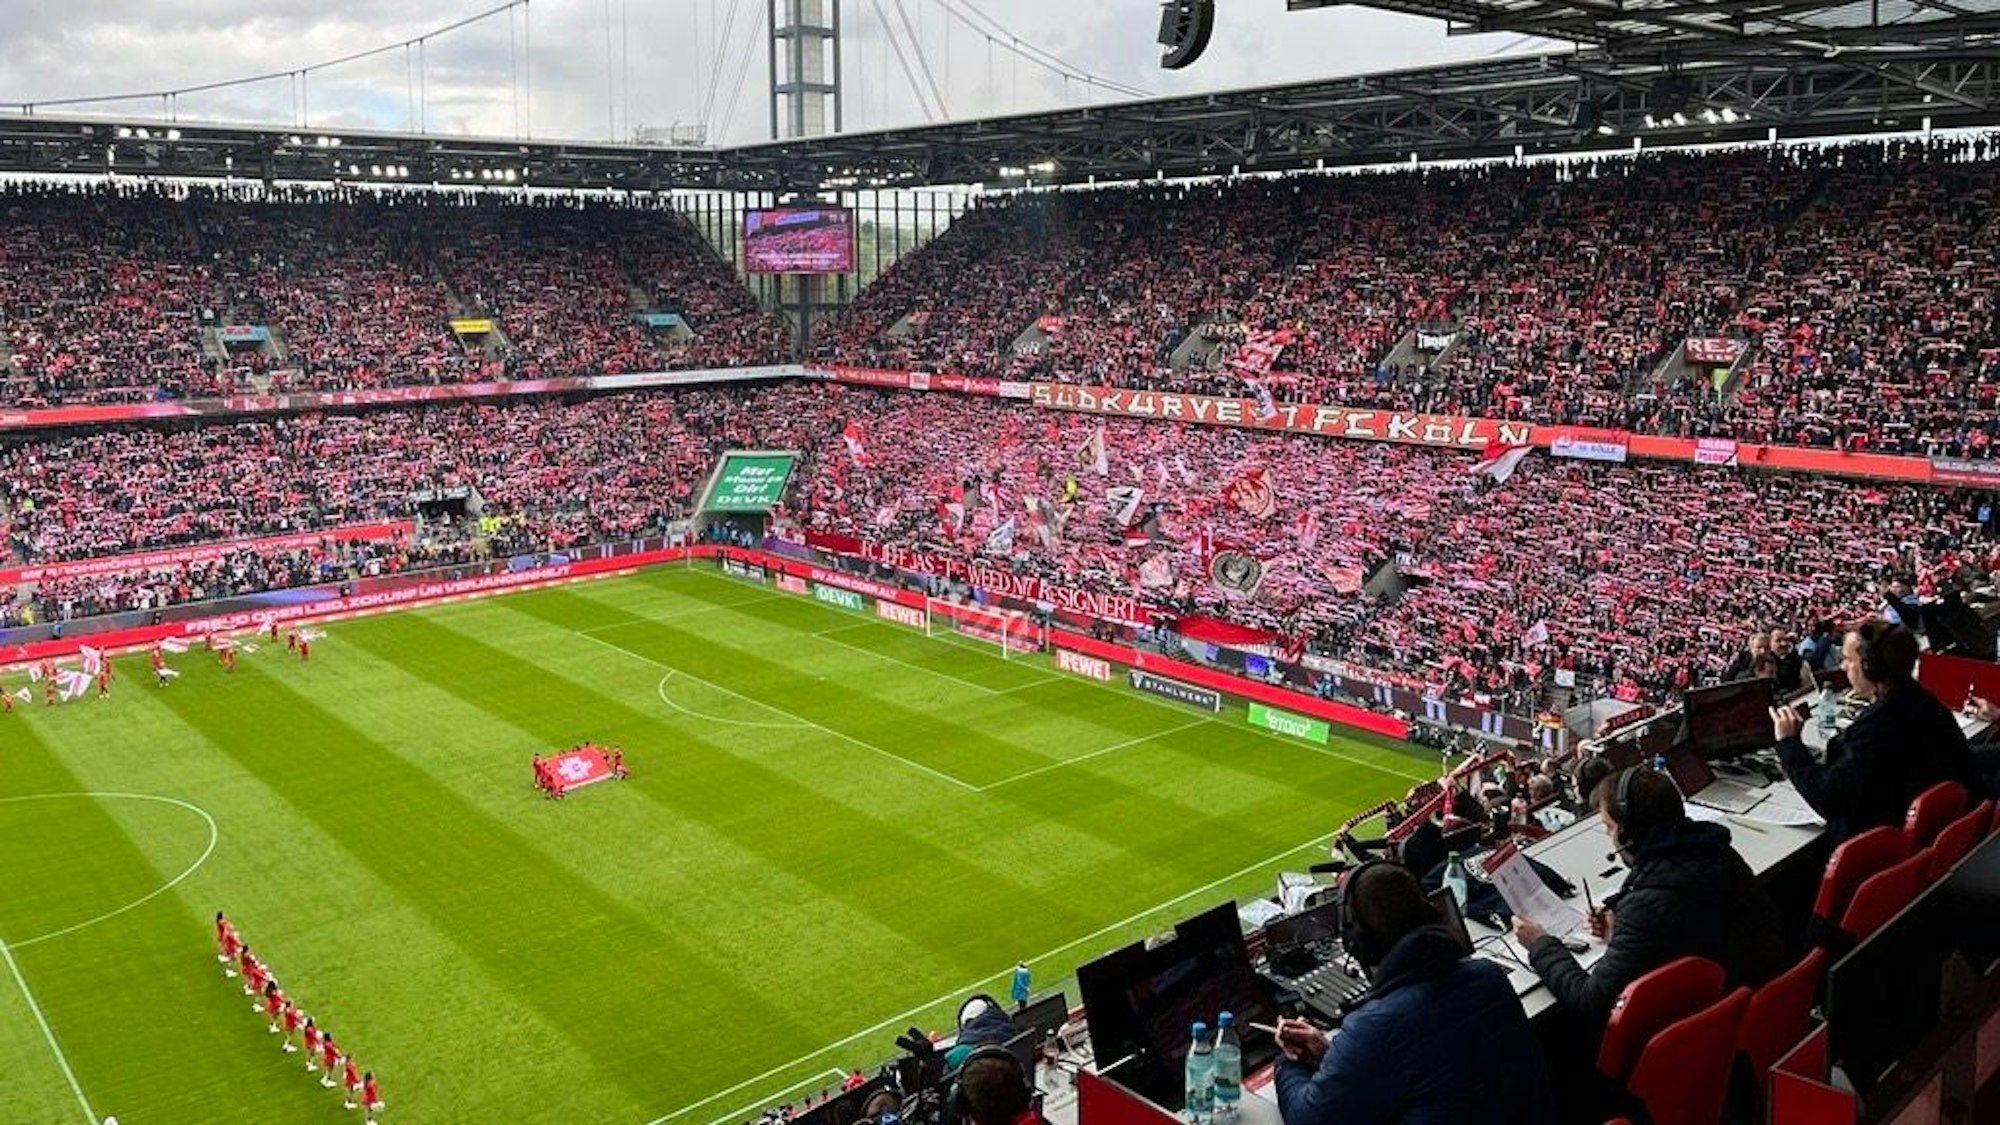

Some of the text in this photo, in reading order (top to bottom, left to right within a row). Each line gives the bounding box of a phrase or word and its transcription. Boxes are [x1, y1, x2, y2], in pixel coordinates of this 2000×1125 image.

[1034, 386, 1241, 422] SÜDKURVE
[1387, 415, 1529, 446] KÖLN
[716, 495, 769, 504] DEVK
[816, 586, 857, 608] DEVK
[1039, 579, 1137, 620] RESIGNIERT
[879, 601, 919, 626] REWE
[1060, 651, 1104, 678] REWE
